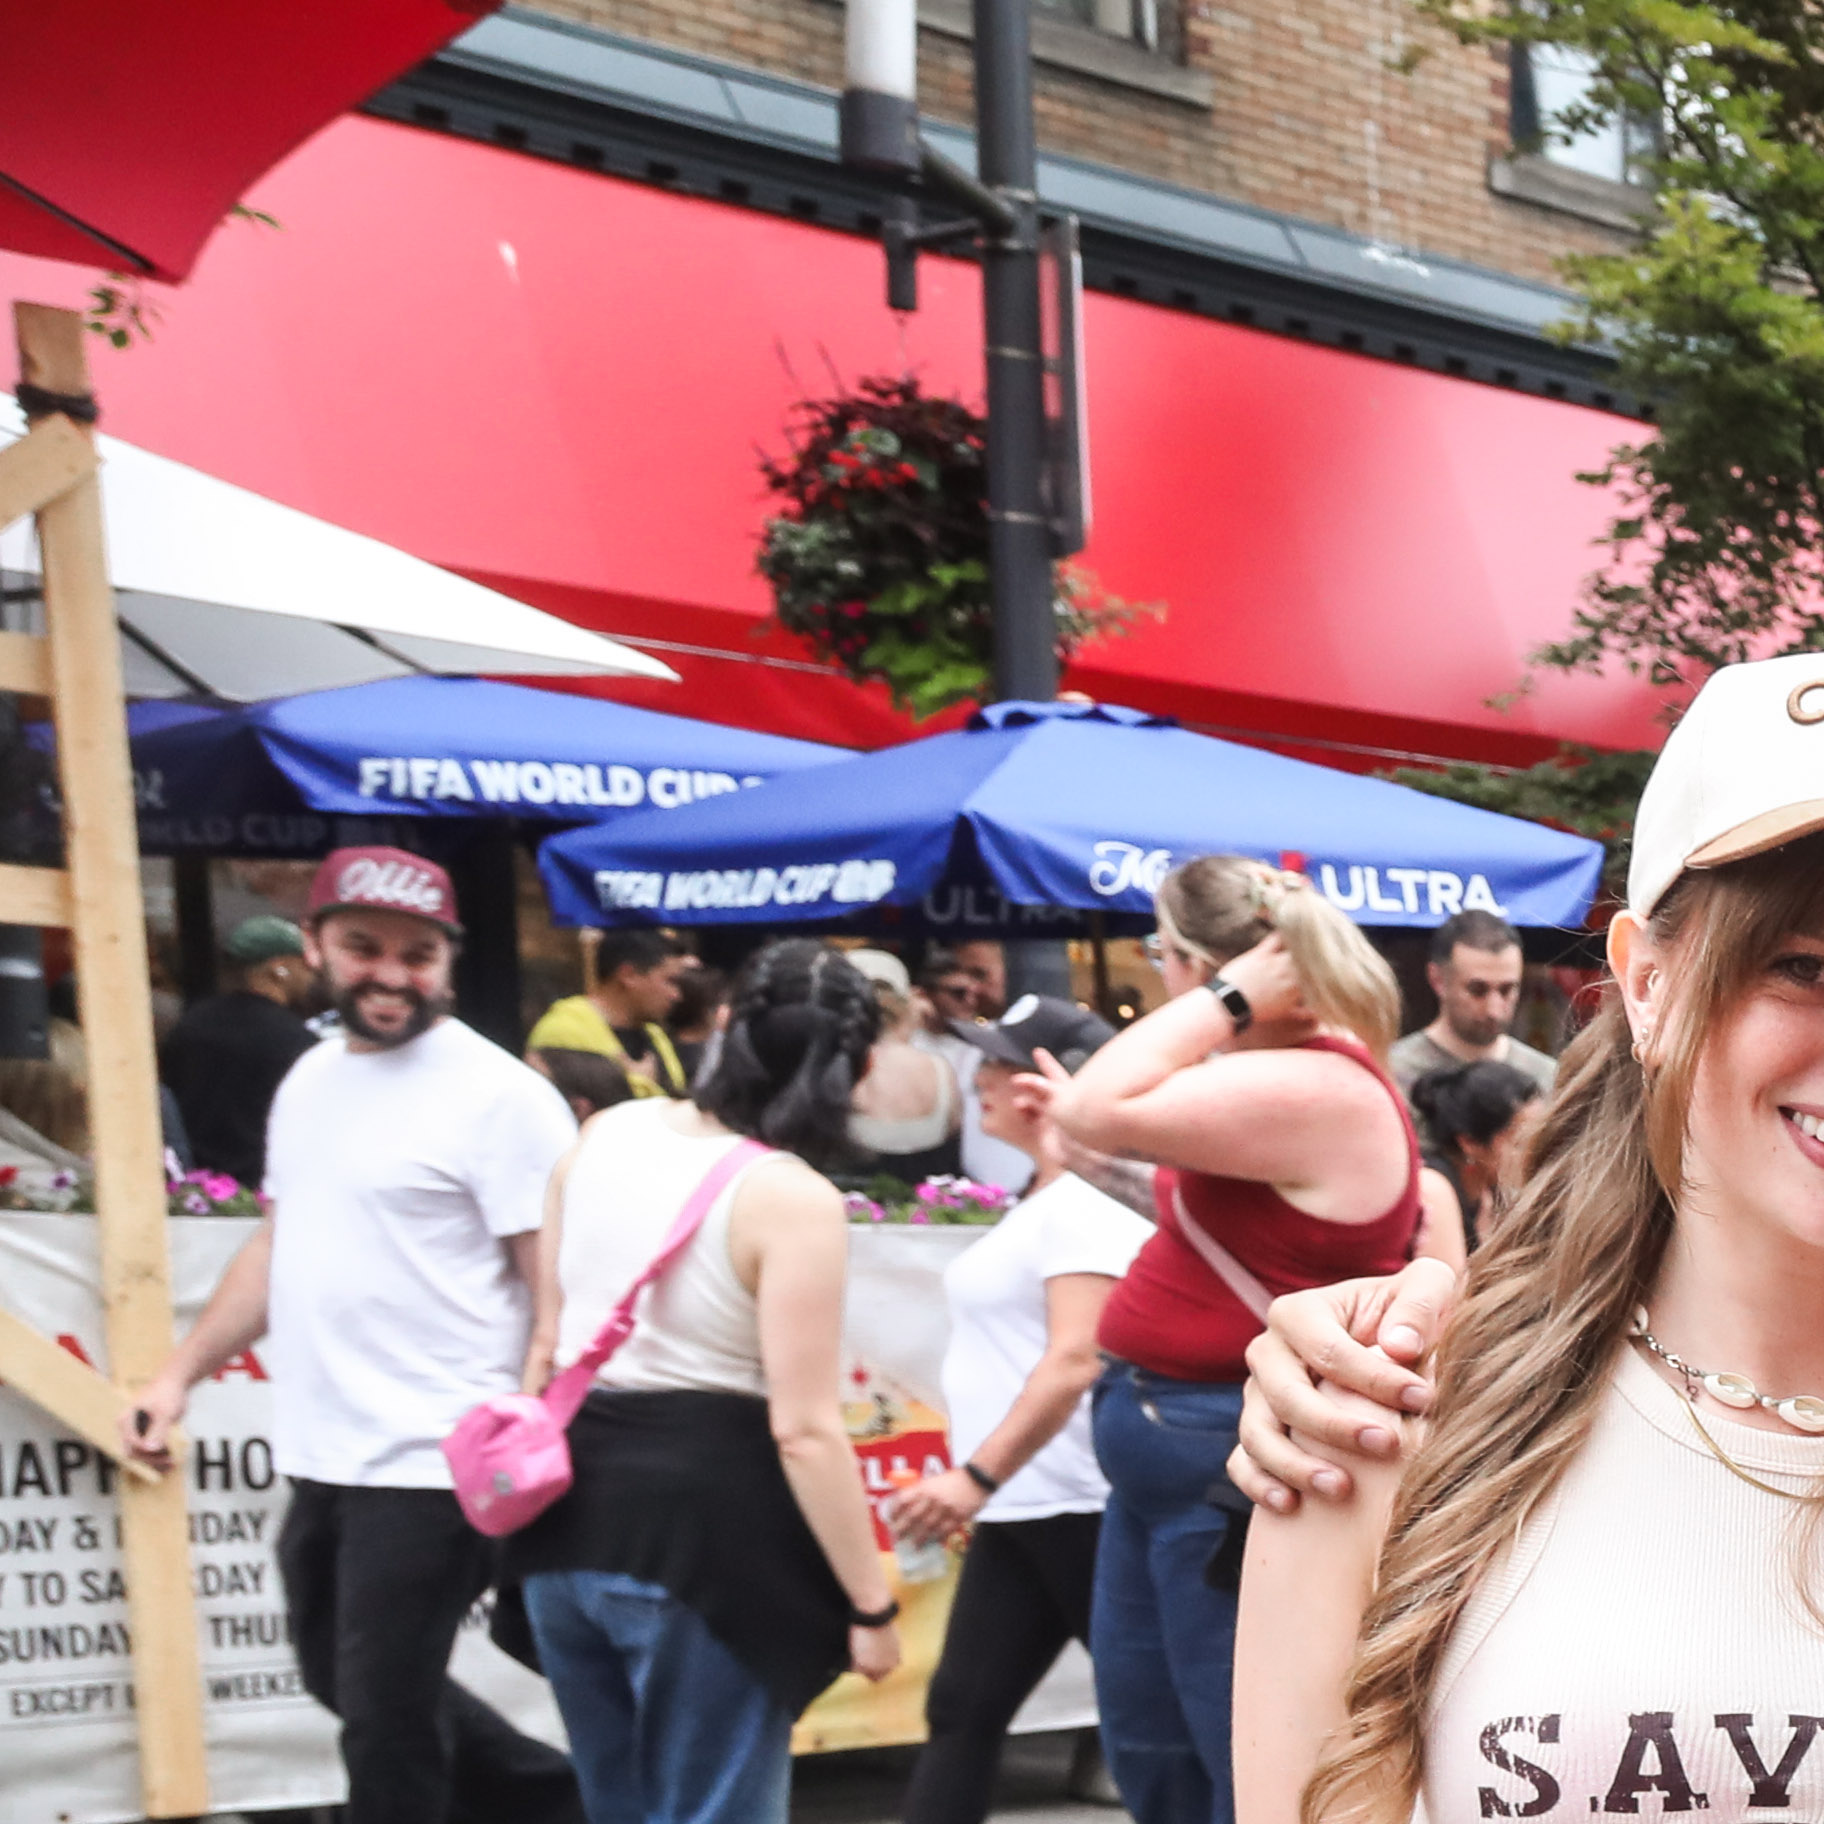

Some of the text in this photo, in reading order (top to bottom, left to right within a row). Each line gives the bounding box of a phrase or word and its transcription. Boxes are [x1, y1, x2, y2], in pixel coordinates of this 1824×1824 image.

[357, 757, 475, 801] FIFA
[471, 760, 645, 807] WORLD
[336, 857, 444, 912] Ollie
[594, 869, 663, 910] FIFA
[663, 867, 779, 911] WORLD
[773, 862, 838, 905] CUP
[1320, 863, 1500, 916] ULTRA
[73, 1515, 98, 1551] &
[20, 1572, 66, 1607] TO
[210, 1613, 284, 1648] THU
[11, 1684, 114, 1718] EXCEPT
